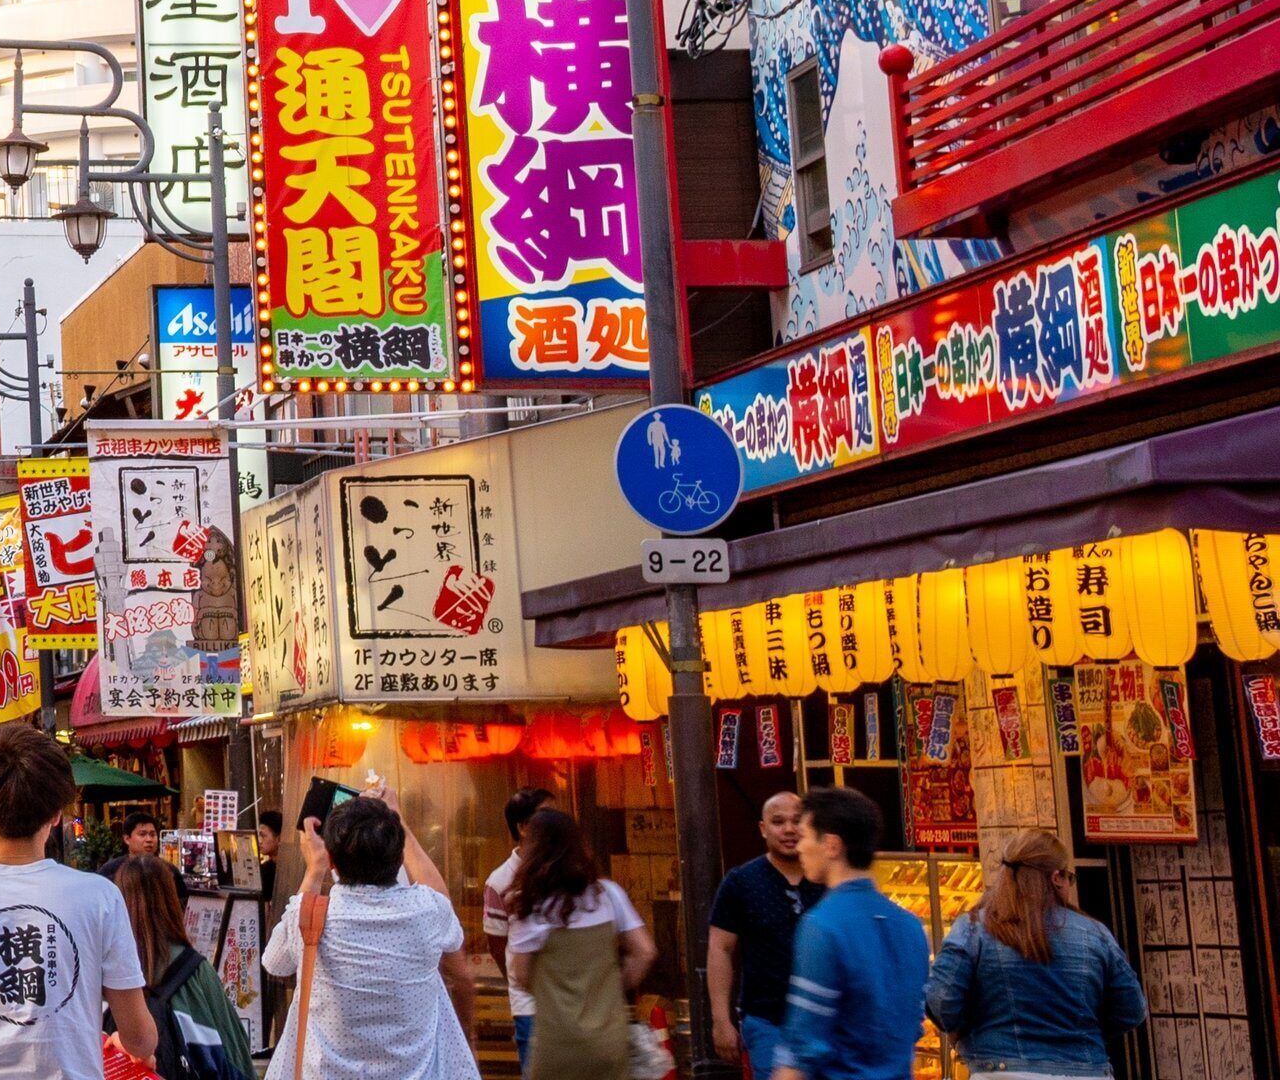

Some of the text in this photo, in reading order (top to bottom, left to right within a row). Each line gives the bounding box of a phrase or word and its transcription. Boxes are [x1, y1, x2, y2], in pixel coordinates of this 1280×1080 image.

[277, 44, 386, 319] 通天閣
[378, 44, 429, 315] TSUTENKAKU
[647, 550, 723, 574] 9-22
[1076, 563, 1113, 638] 寿司
